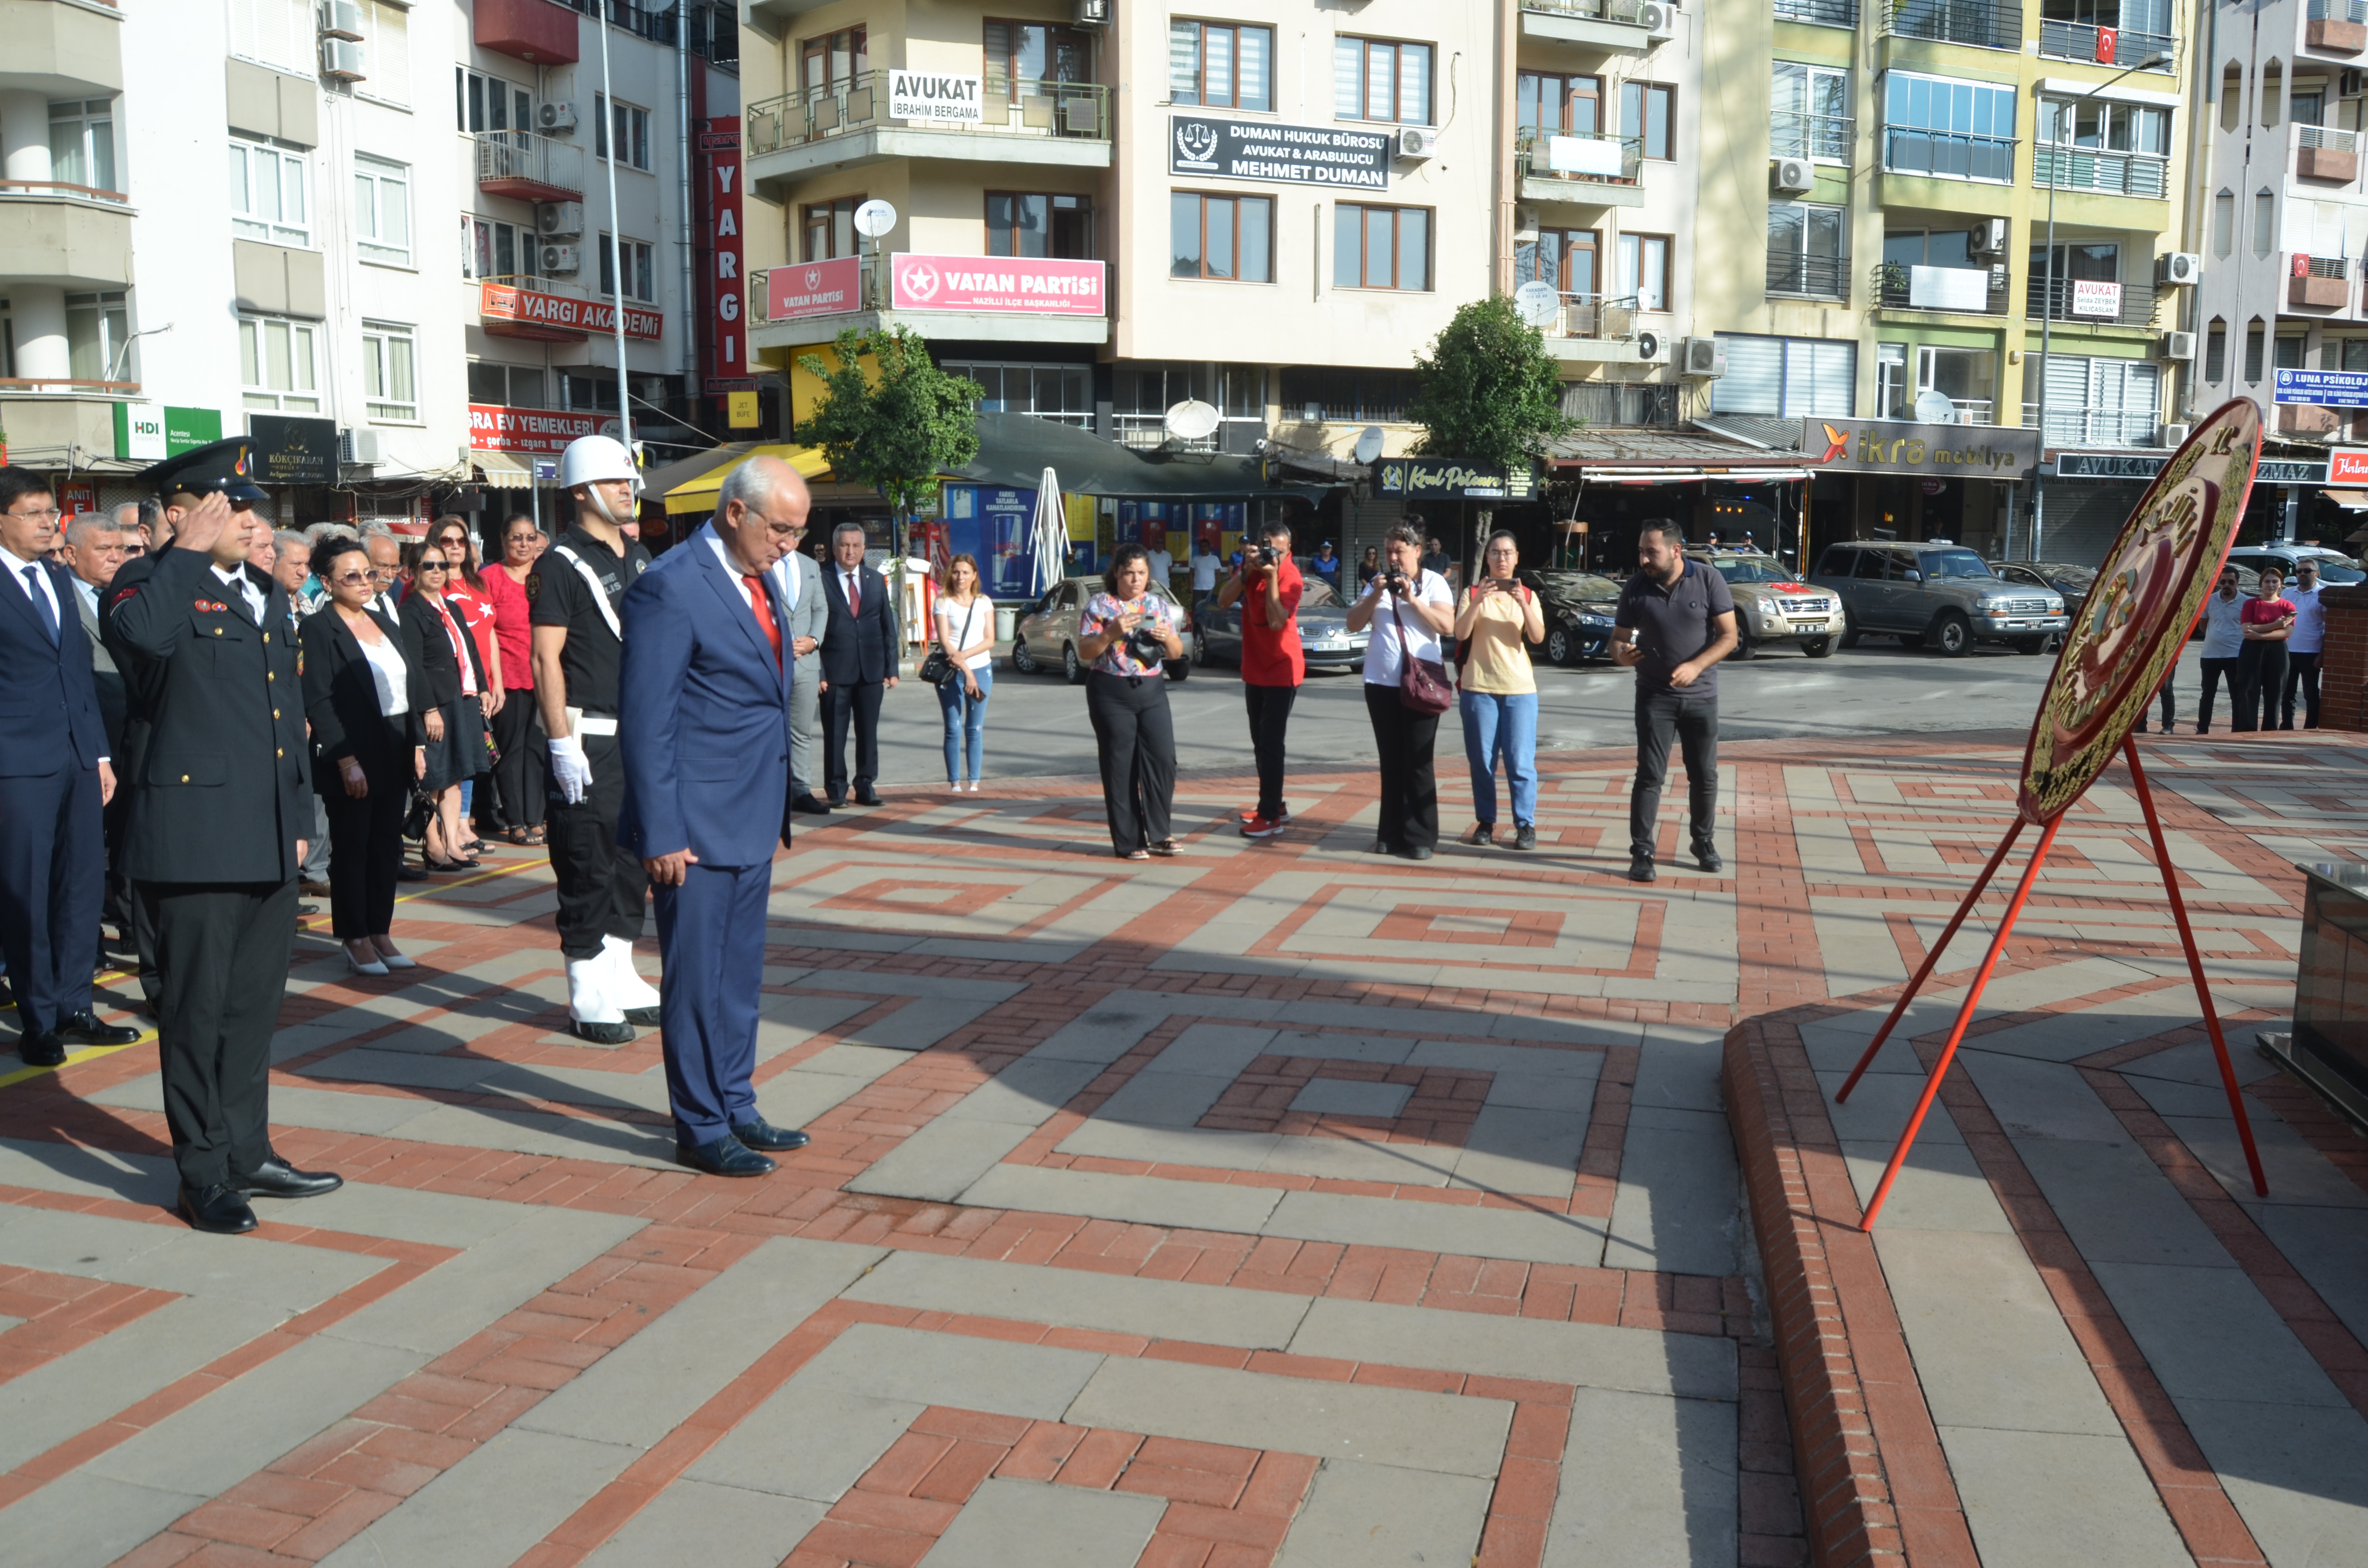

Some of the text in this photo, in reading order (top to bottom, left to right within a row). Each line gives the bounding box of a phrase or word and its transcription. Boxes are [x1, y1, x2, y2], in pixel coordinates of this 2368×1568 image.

[895, 75, 976, 100] AVUKAT
[894, 99, 978, 119] İBRAHİM BERGAMA
[703, 135, 740, 148] yarg
[1231, 126, 1384, 149] DUMAN HUKUK BÜROSU
[1243, 145, 1373, 165] AVUKAT & ARABULUCU
[1232, 160, 1383, 185] MEHMET DUMAN
[717, 166, 738, 362] YARGI
[945, 272, 1014, 292] VATAN
[2078, 284, 2117, 296] AVUKAT
[523, 295, 578, 323] YARGI
[784, 295, 810, 307] VATAN
[973, 296, 1070, 307] NAZİLLİ İLÇE BAŞKANLIĞI
[2295, 374, 2368, 386] LUNA PSİKOLOJ
[135, 421, 159, 434] HDI
[469, 412, 595, 436] SRA EV YEMEKLERİ
[487, 434, 511, 448] çorba
[521, 439, 546, 450] ızgara
[1934, 445, 2015, 471] mobilya
[1408, 466, 1445, 490] Kral
[2077, 457, 2309, 480] AVUKAT ZMAZ
[2043, 477, 2065, 485] Orkun
[2068, 477, 2097, 486] KIZMAZ
[67, 490, 90, 500] ANIT
